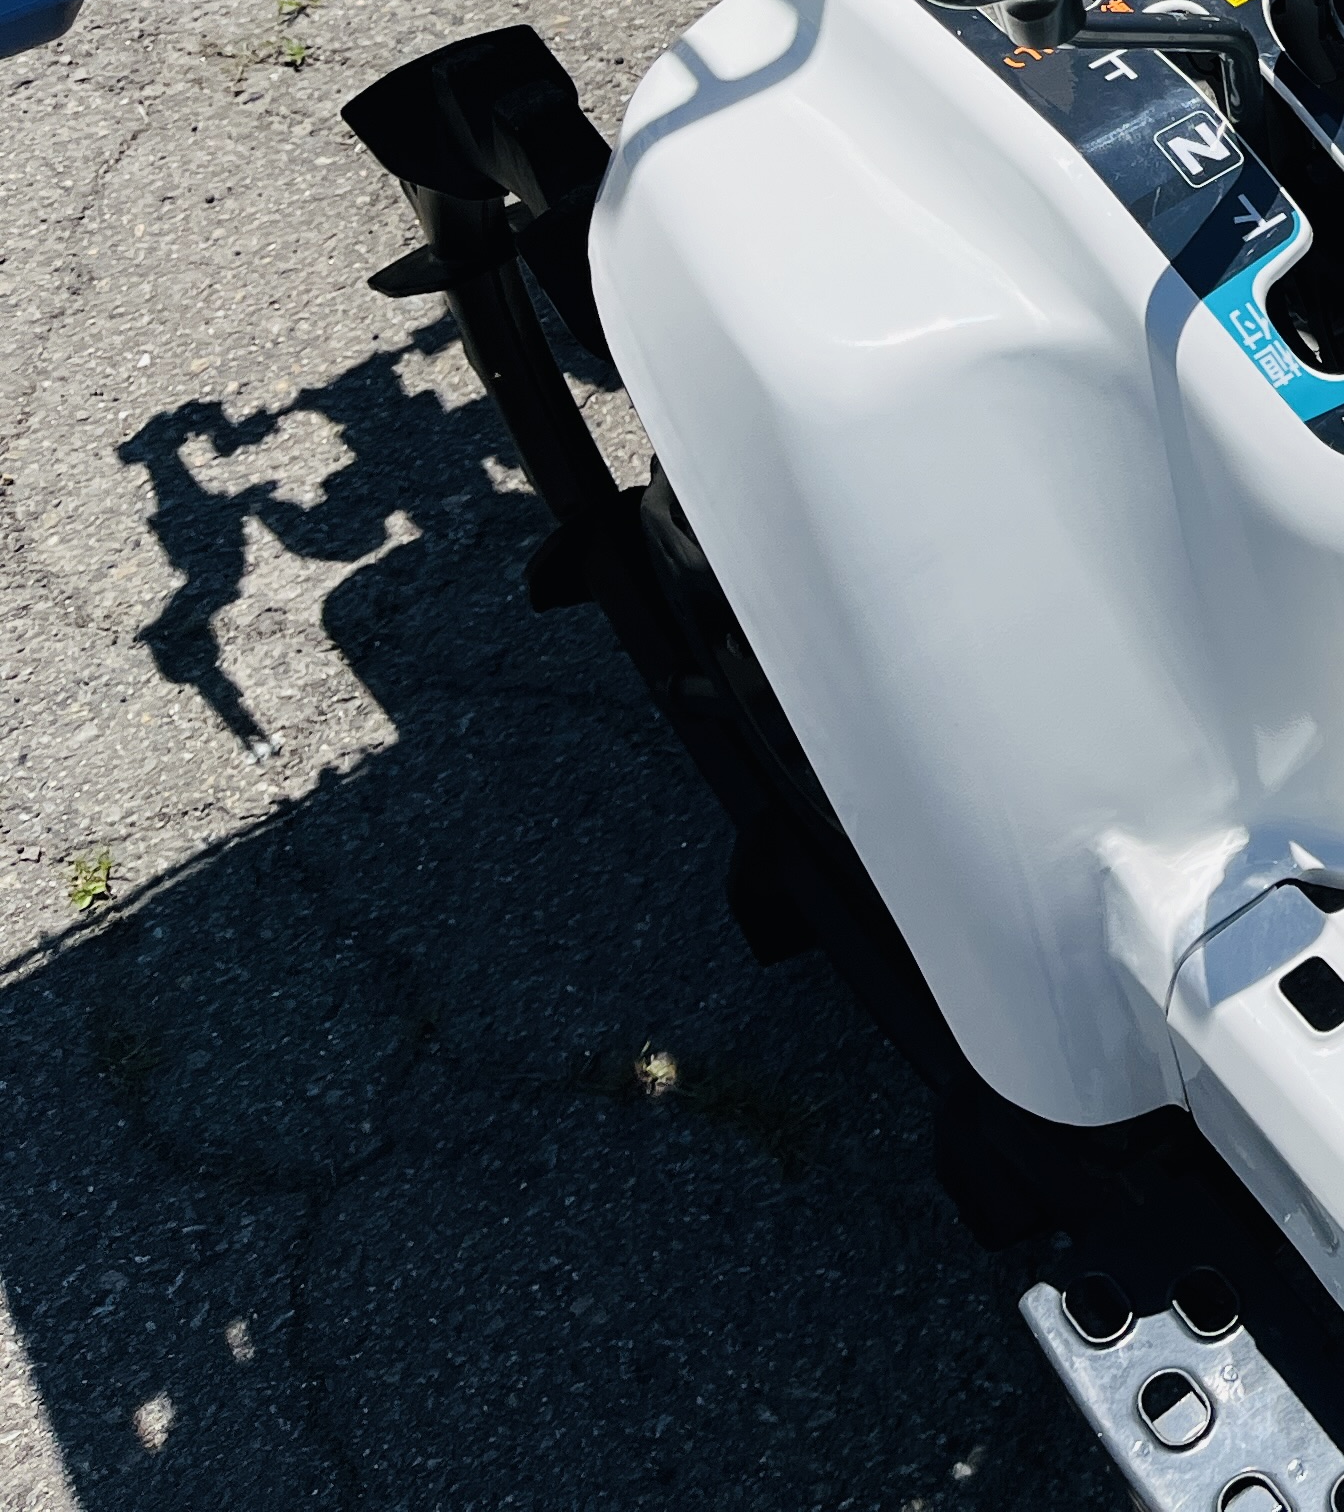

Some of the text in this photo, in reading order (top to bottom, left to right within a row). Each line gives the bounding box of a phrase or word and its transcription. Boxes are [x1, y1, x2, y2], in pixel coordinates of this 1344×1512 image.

[1088, 48, 1138, 81] 上
[1167, 121, 1232, 176] N
[1233, 193, 1287, 244] 下
[1229, 301, 1304, 389] 植付
